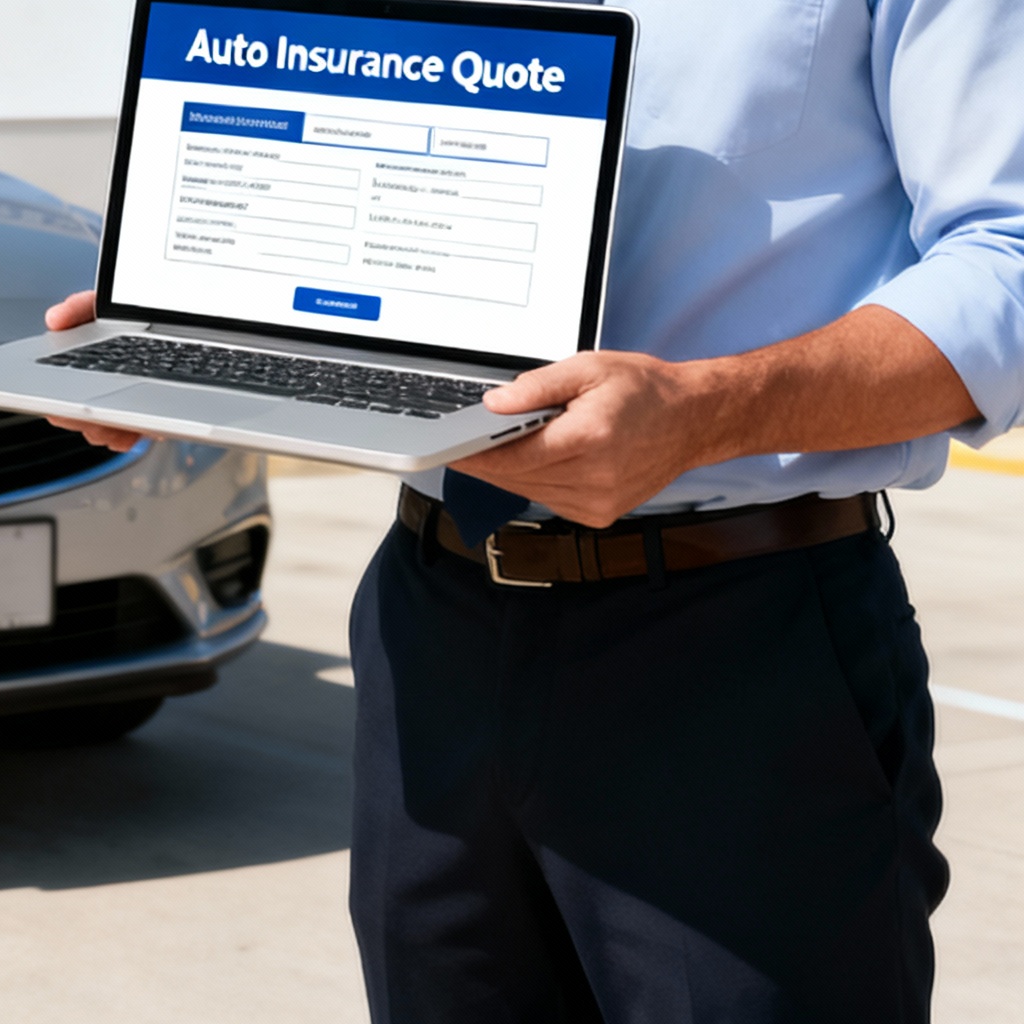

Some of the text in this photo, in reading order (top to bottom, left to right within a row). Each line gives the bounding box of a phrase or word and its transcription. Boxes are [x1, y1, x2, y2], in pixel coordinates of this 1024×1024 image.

[185, 28, 566, 94] Auto Insurance Quote
